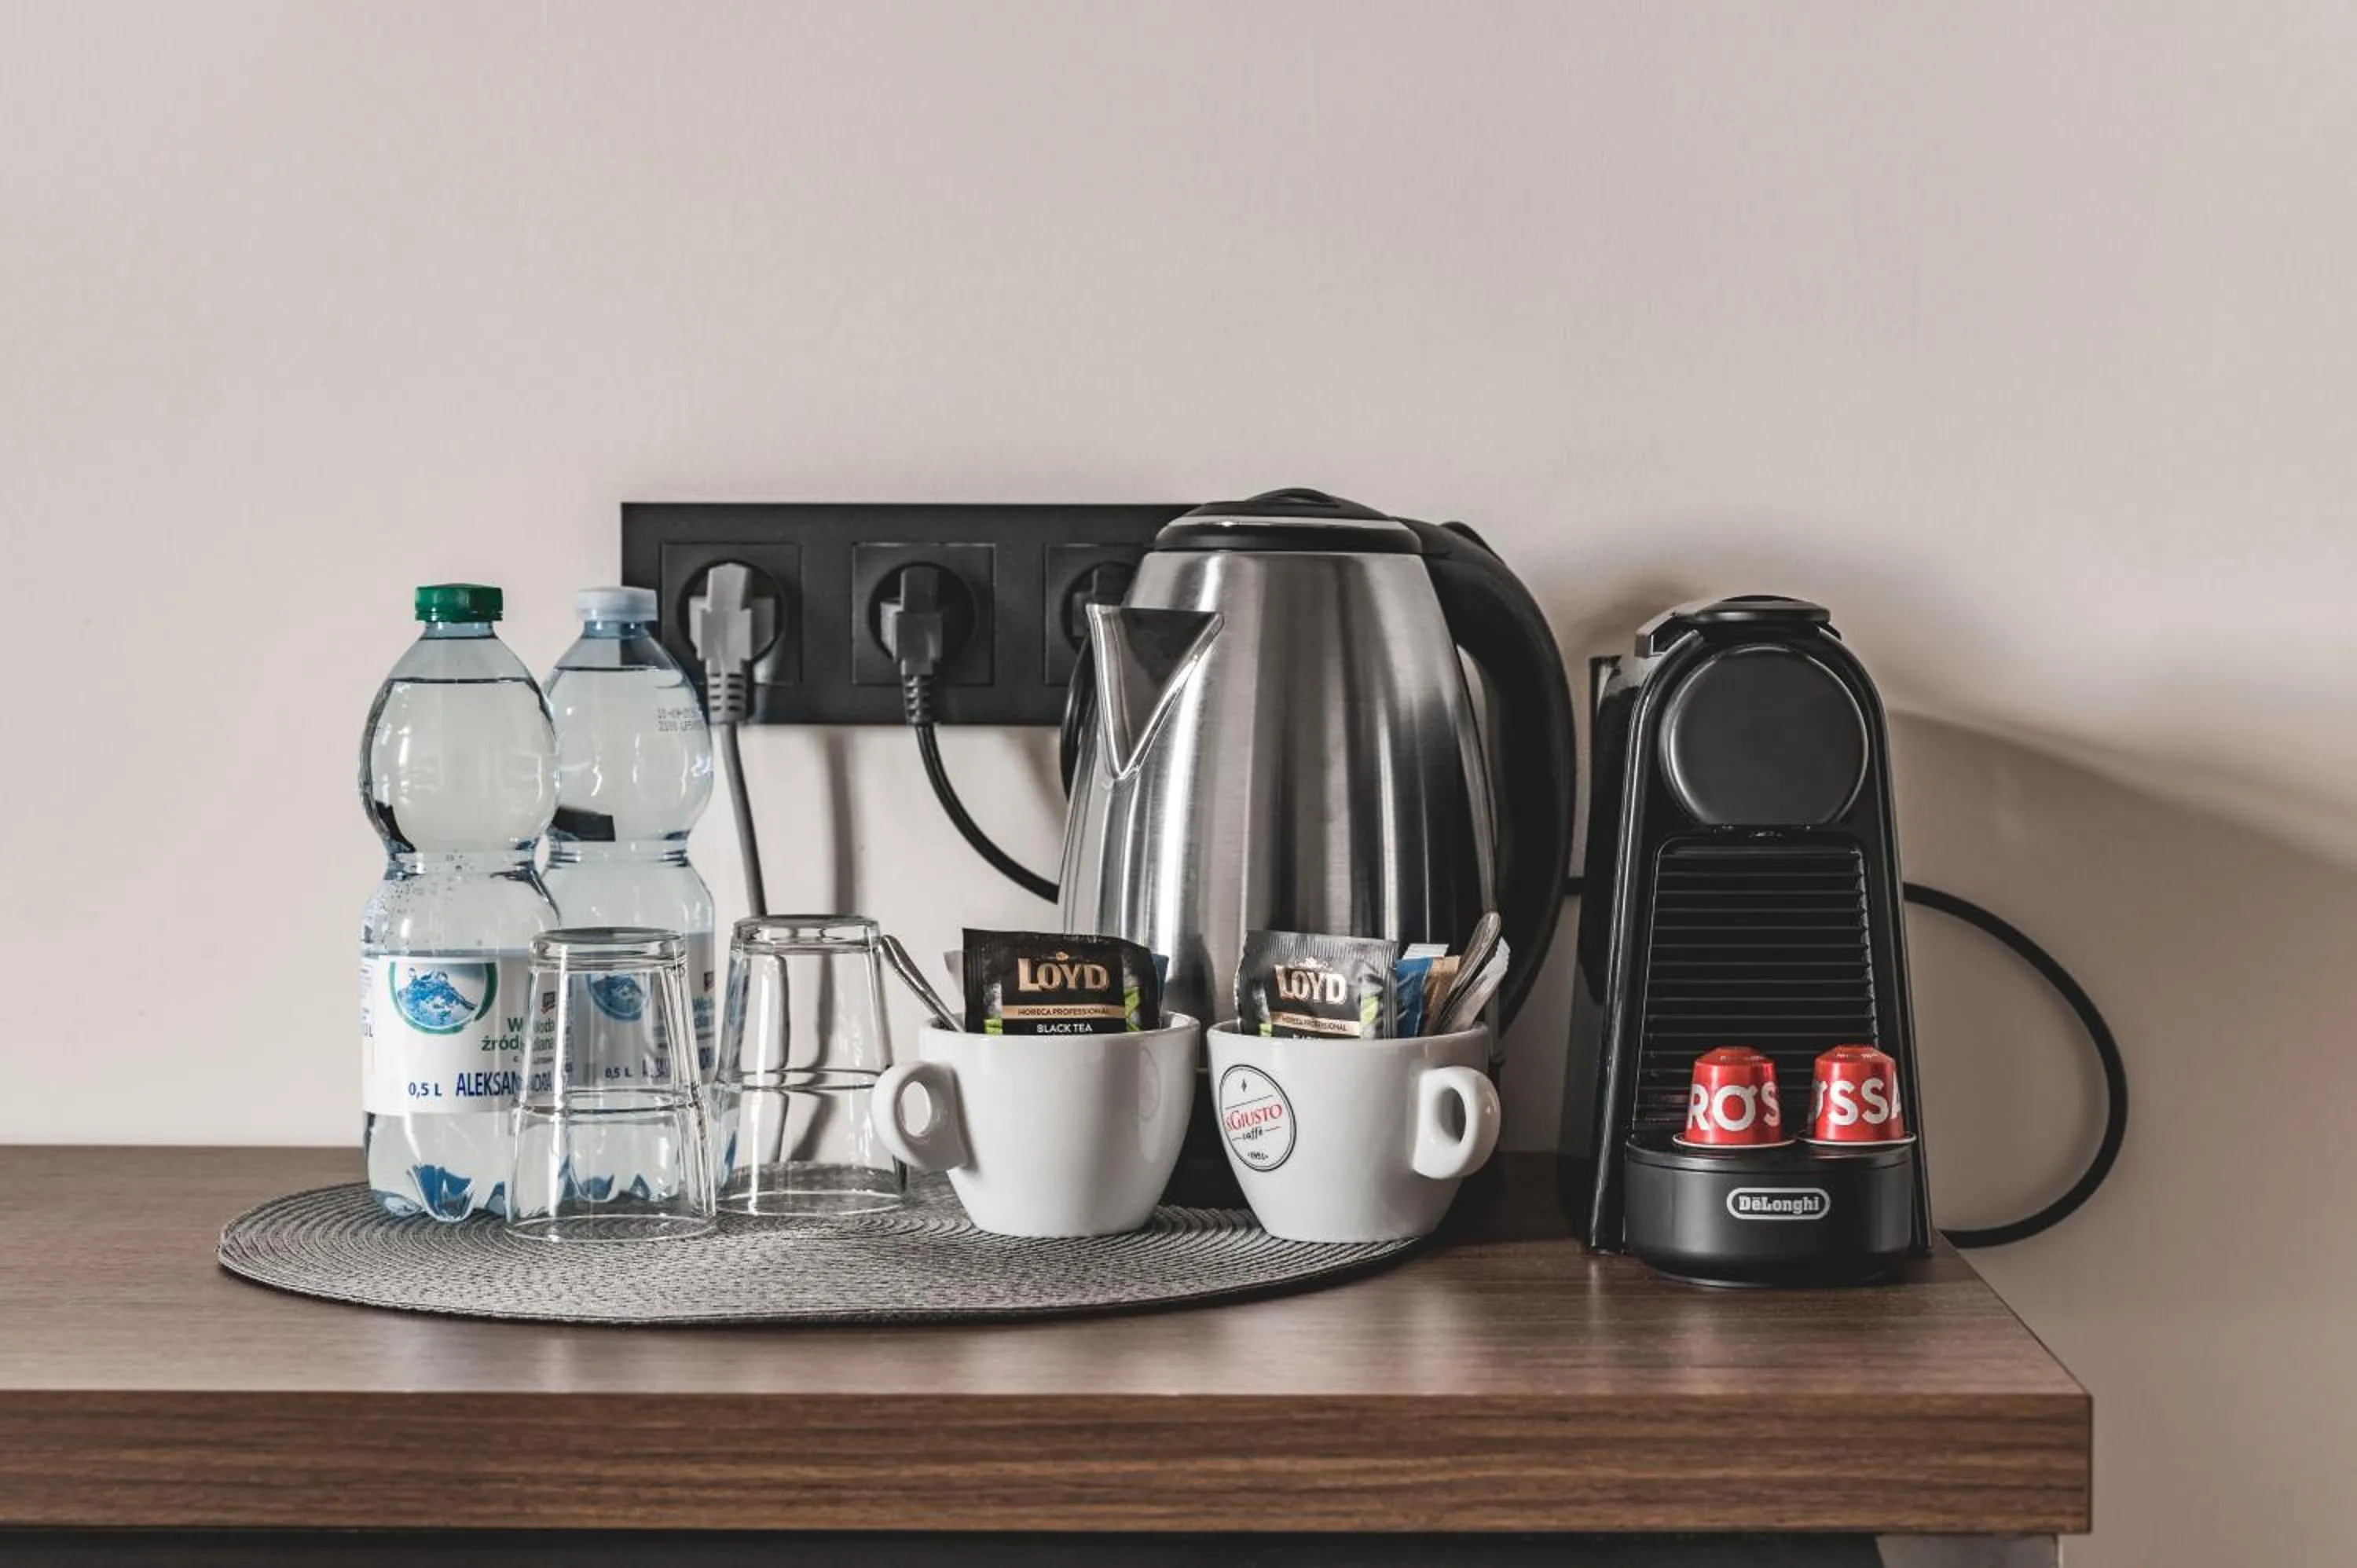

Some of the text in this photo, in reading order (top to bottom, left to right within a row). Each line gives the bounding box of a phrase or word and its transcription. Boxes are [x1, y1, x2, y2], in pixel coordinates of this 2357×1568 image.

[1017, 958, 1110, 991] LOYD
[1274, 964, 1347, 1005] LOYD
[1017, 1007, 1109, 1017] HORECA PROFESSIONAL
[1036, 1024, 1093, 1034] BLACK TEA
[408, 1082, 442, 1099] 0,5 L
